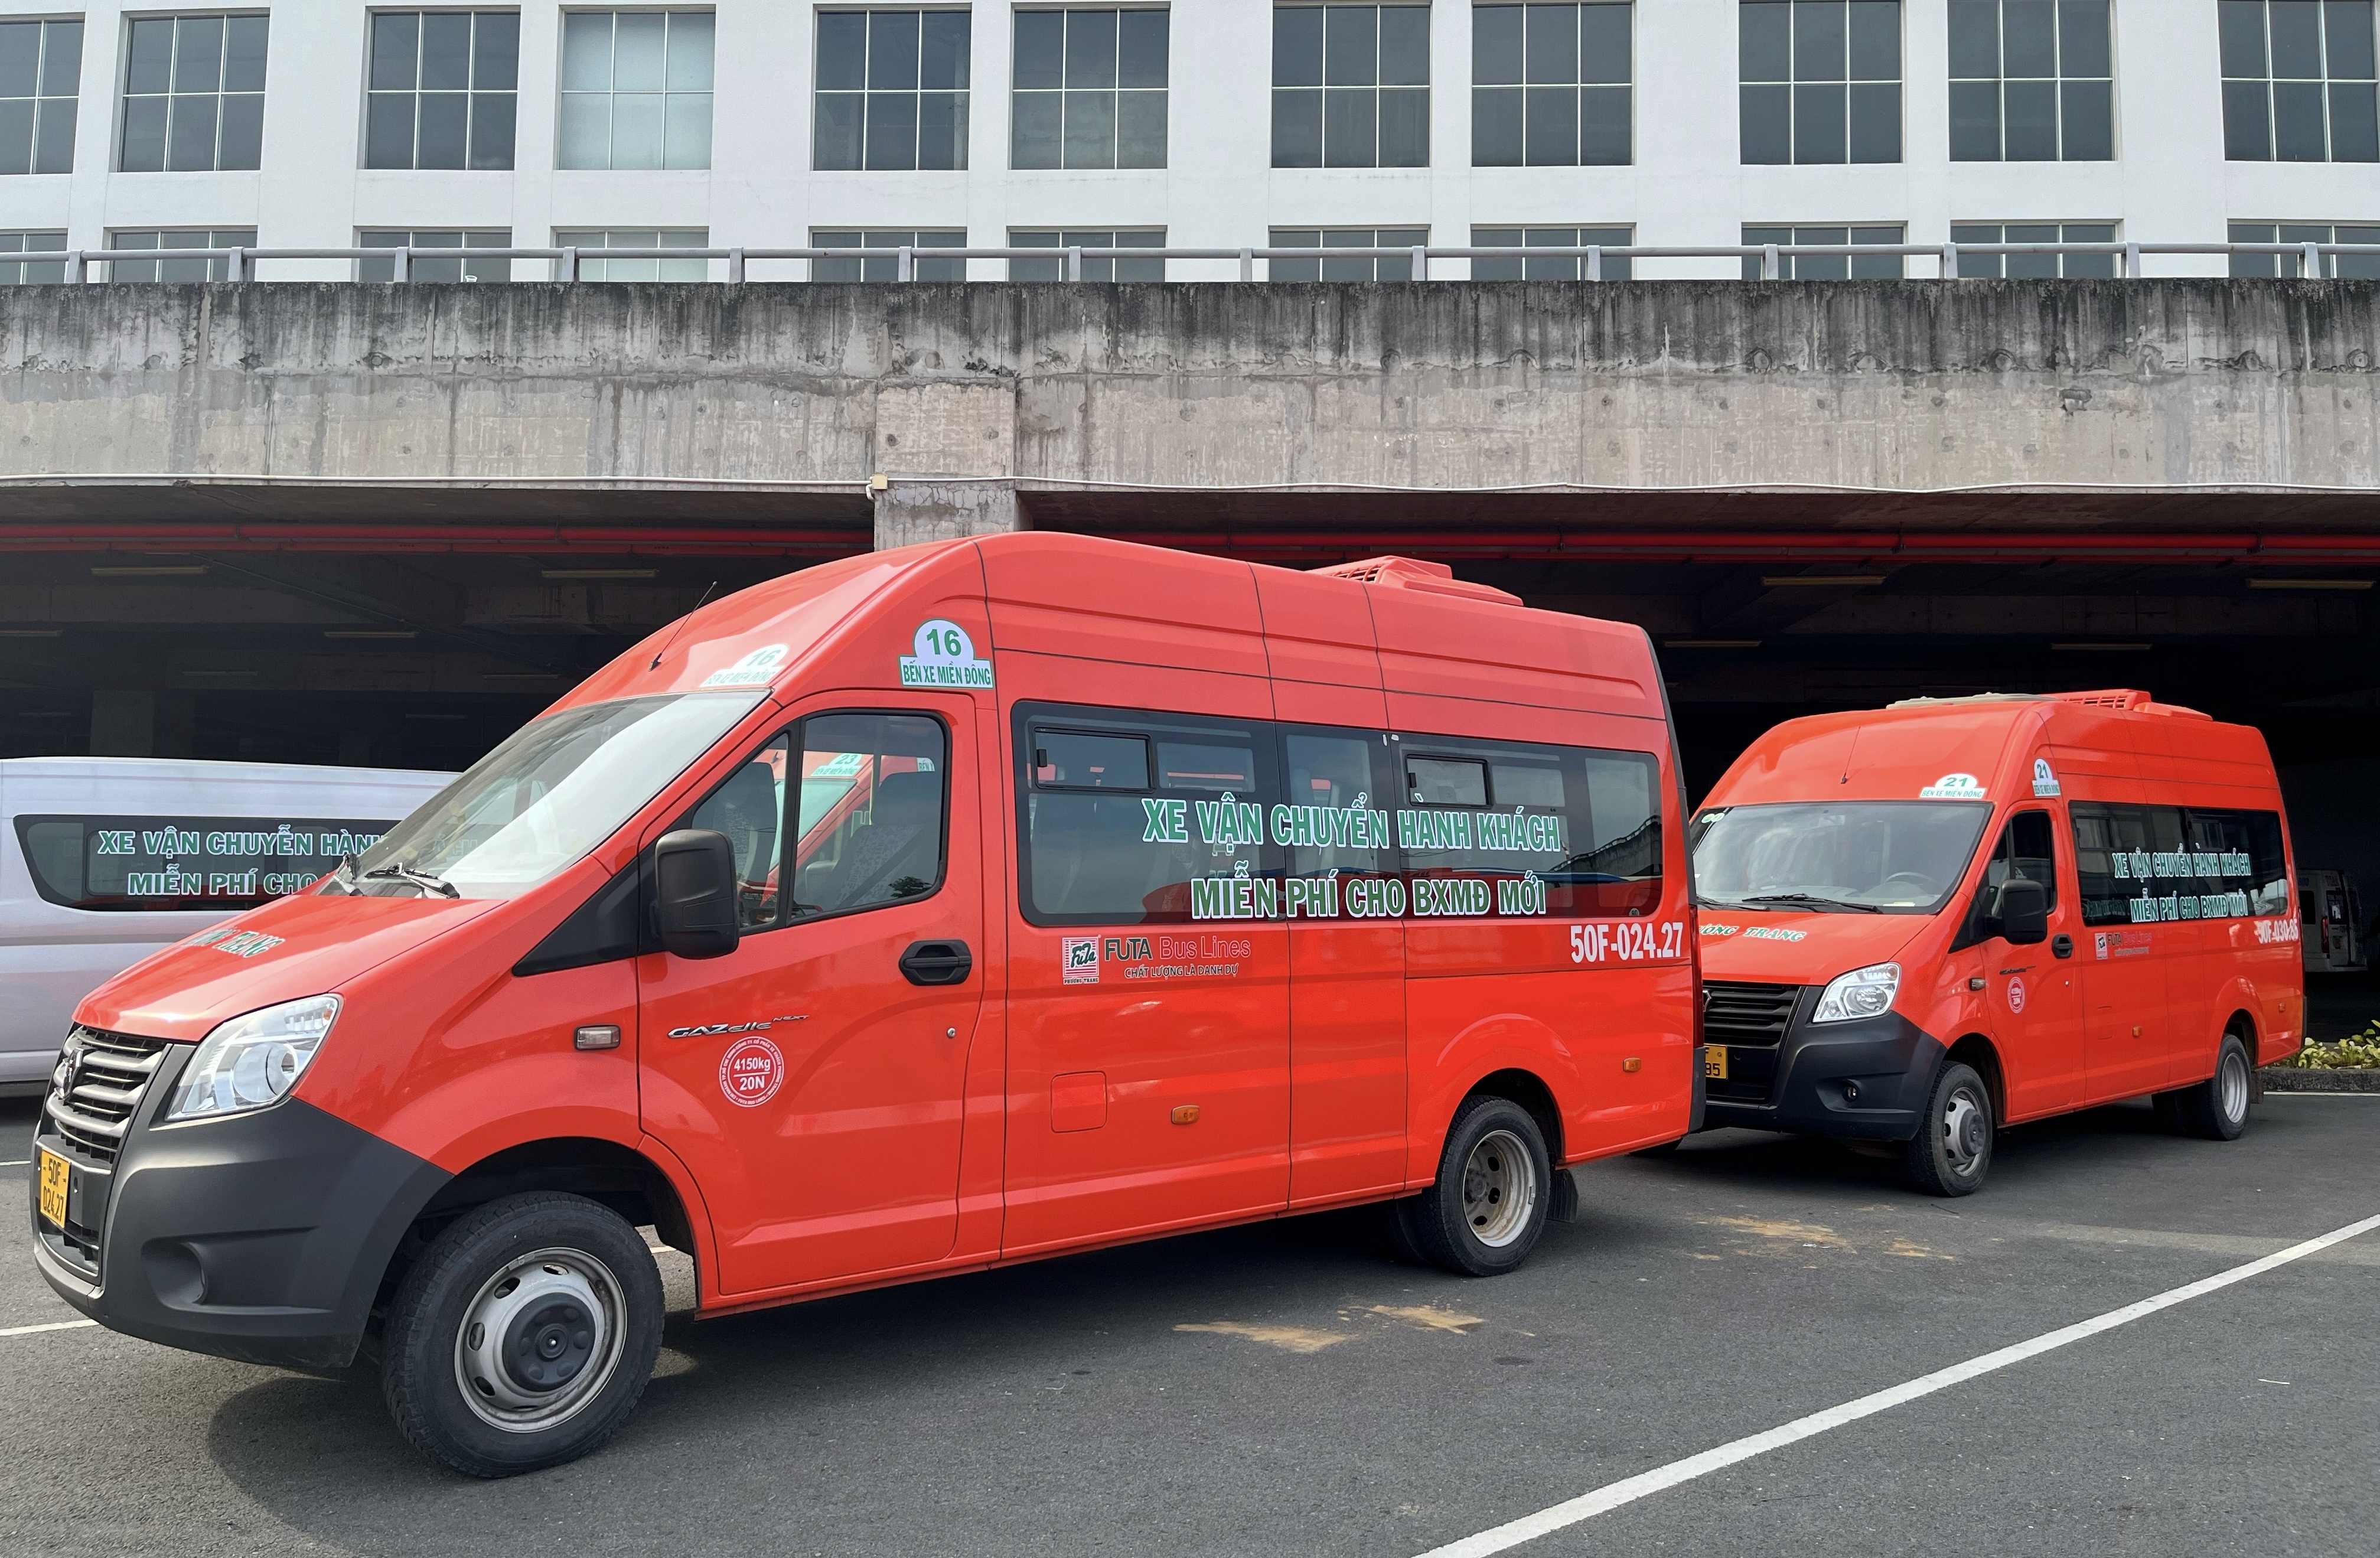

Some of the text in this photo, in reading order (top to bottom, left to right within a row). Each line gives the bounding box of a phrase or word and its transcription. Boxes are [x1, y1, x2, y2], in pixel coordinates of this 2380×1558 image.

[927, 629, 961, 656] 16
[746, 649, 781, 667] 16
[902, 660, 992, 685] BẾN XE MIỀN ĐÔNG
[834, 754, 858, 764] 23
[2037, 764, 2048, 778] 21
[1944, 777, 1968, 787] 21
[1141, 791, 1561, 853] XE VẬN CHUYỂN HÀNH KHÁCH
[97, 830, 135, 855] XE
[142, 826, 200, 859] VẬN
[2112, 842, 2251, 883] XE VẬN CHUYỂN HÀNH KHÁCH
[128, 863, 318, 895] MIỄN PHÍ CHO
[1191, 860, 1277, 920] MIỄN
[1285, 868, 1339, 918] PHÍ
[1345, 878, 1406, 918] CHO
[1411, 879, 1491, 917] BXMĐ
[1498, 870, 1547, 916] MỚI
[2130, 888, 2159, 923] MIỄN
[2159, 890, 2179, 921] PHÍ
[2179, 896, 2200, 920] CHO
[2200, 895, 2229, 918] BXMĐ
[1570, 921, 1684, 963] 50F-024.27
[1743, 927, 1807, 942] TRANG
[1104, 936, 1251, 961] FUTA Bus Lines
[1124, 963, 1240, 980] CHẤT LƯỢNG LÀ DANH DỰ
[733, 1057, 770, 1071] 4150kg
[739, 1075, 765, 1091] 20N
[48, 1158, 61, 1187] 50F
